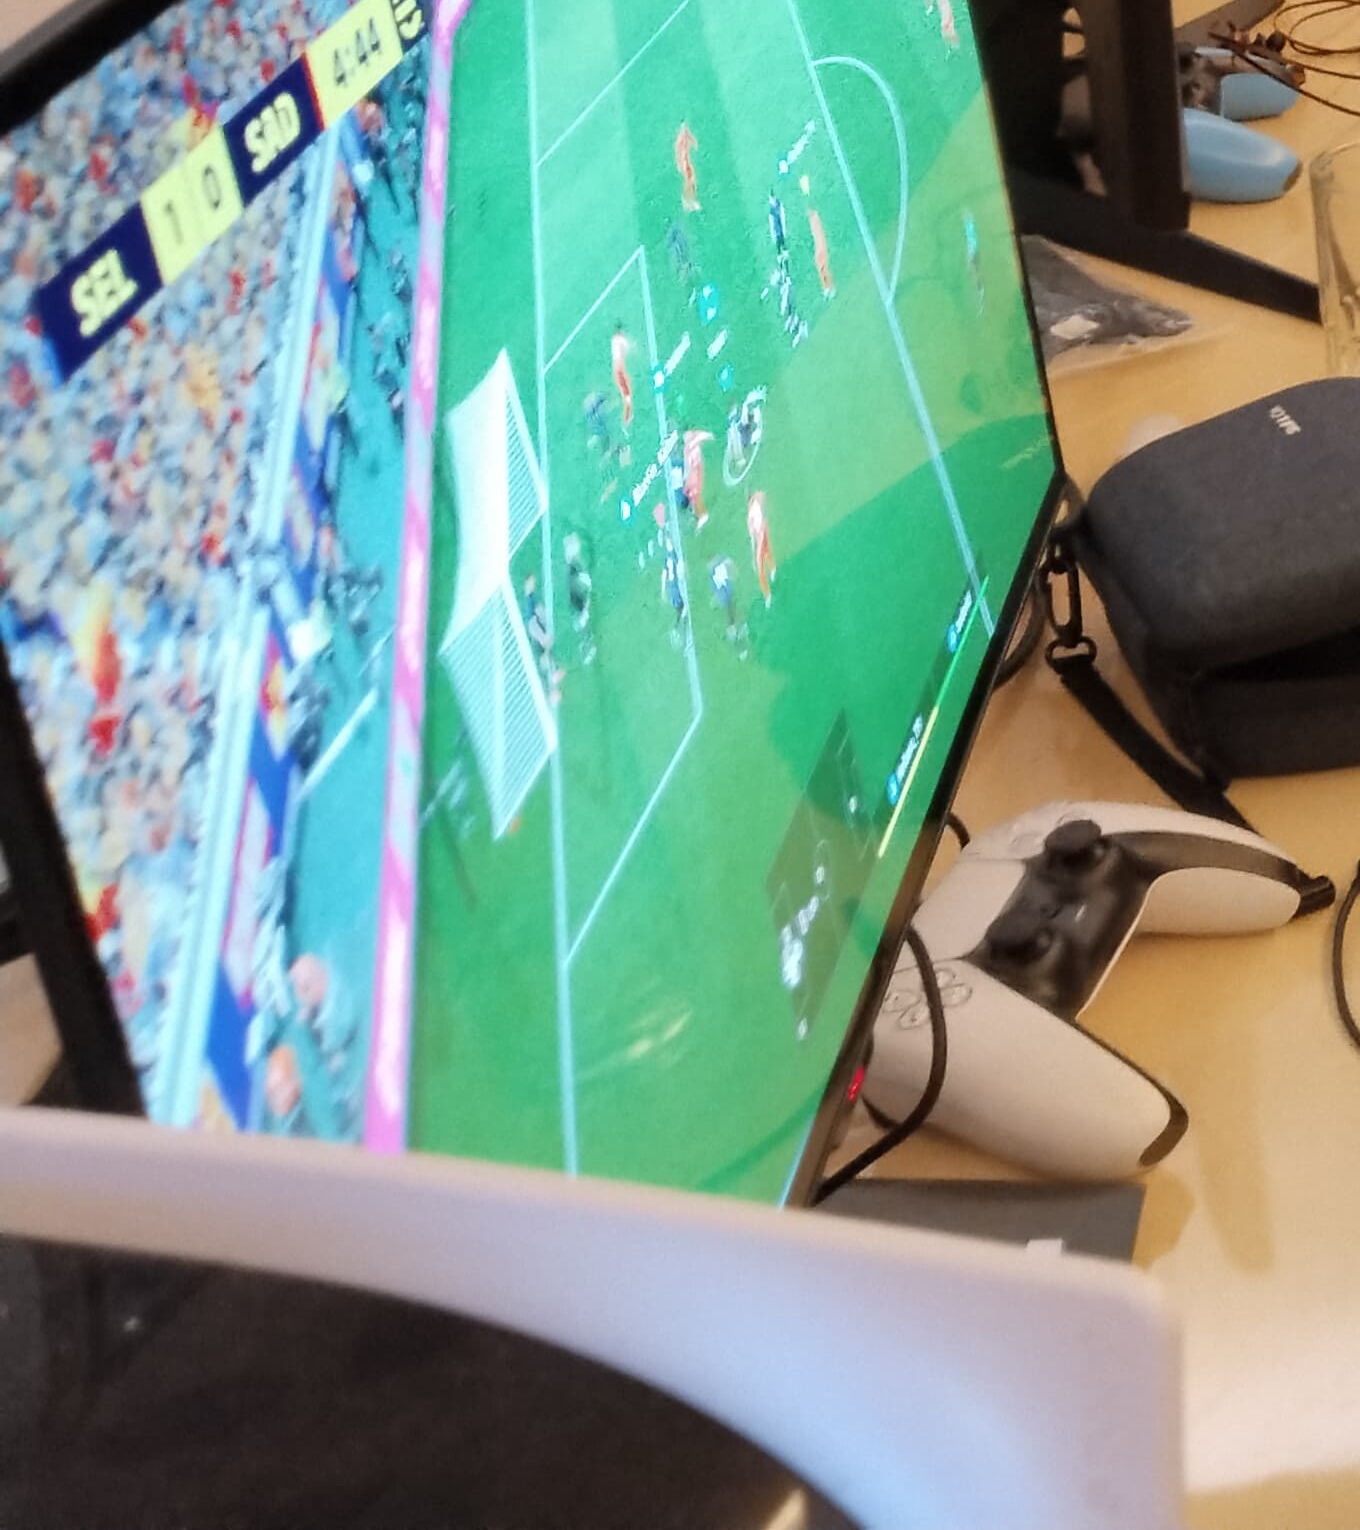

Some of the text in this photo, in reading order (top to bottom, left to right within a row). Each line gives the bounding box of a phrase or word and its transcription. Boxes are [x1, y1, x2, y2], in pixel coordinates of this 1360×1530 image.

[70, 248, 139, 338] SEL
[244, 92, 301, 174] SAD
[331, 17, 382, 89] 4:44
